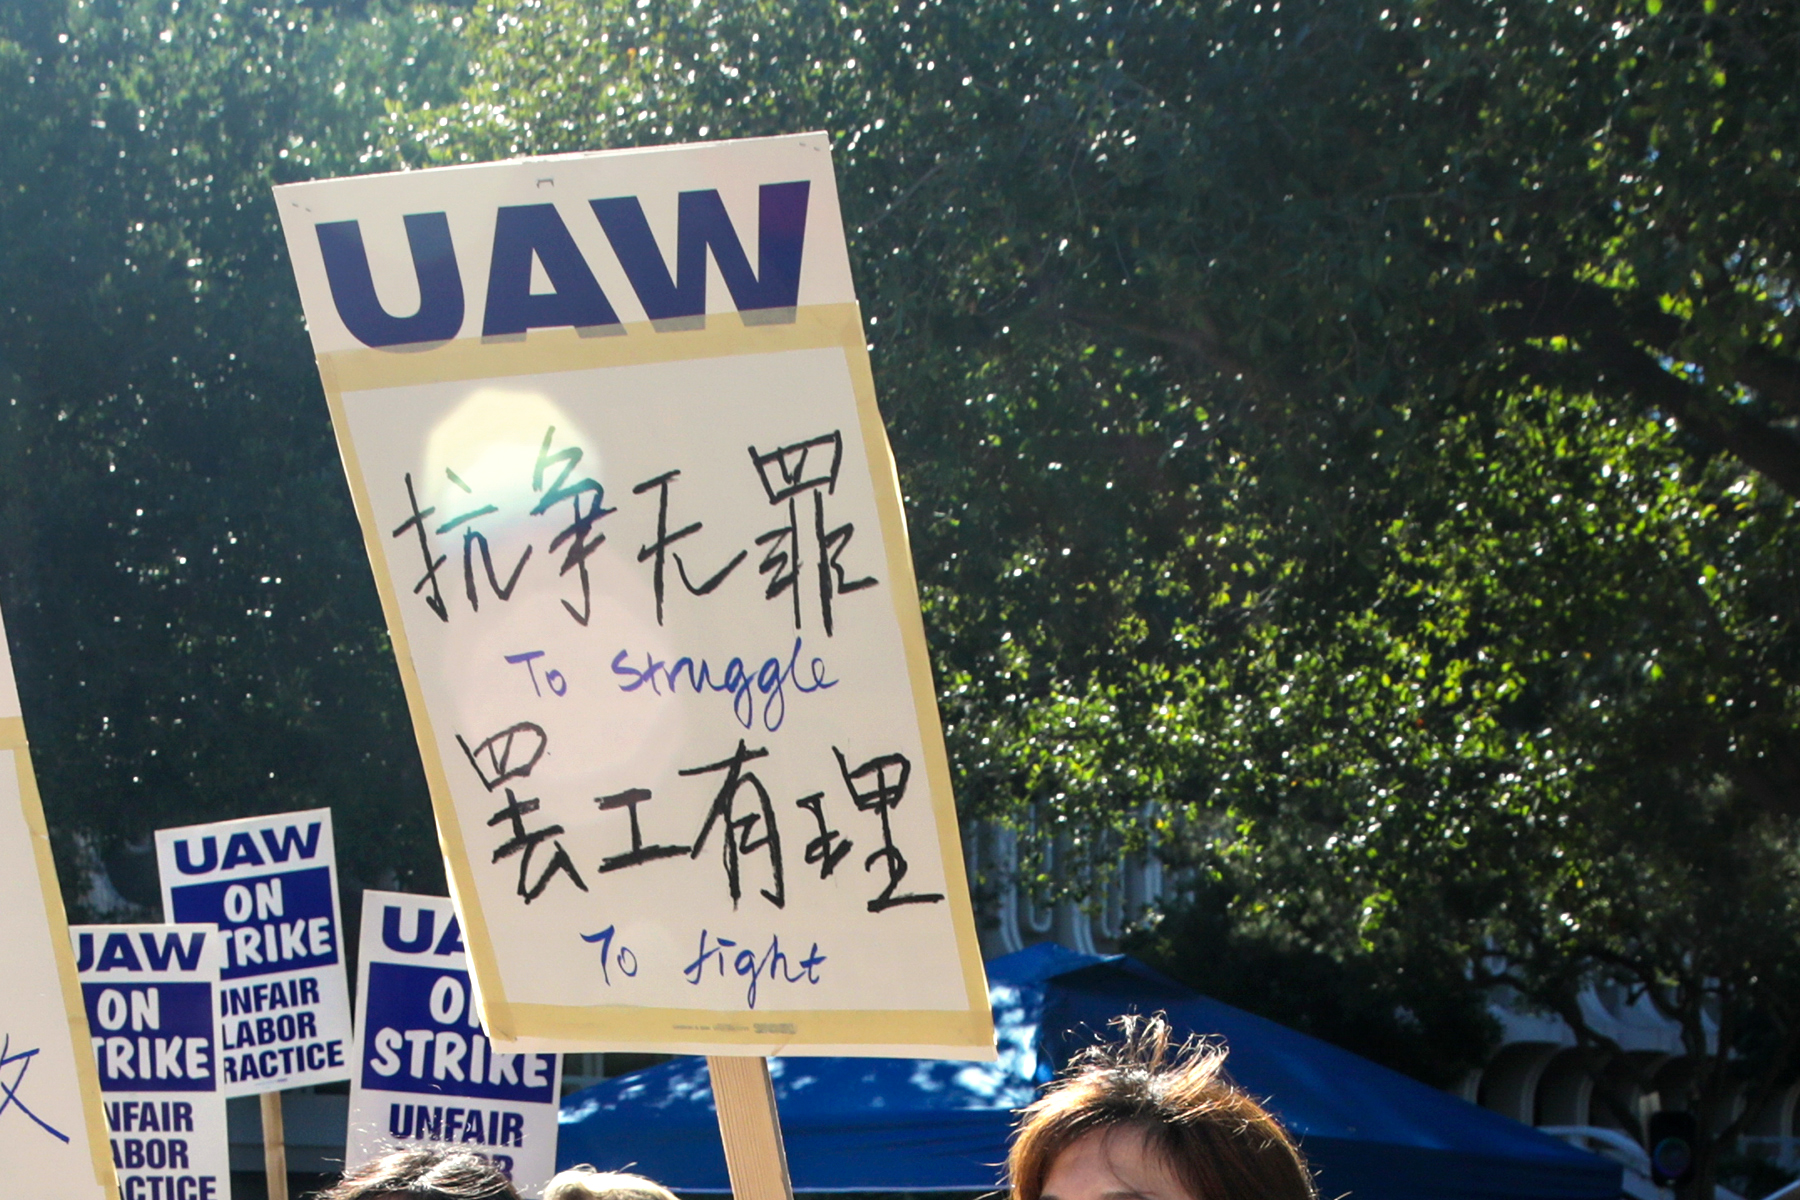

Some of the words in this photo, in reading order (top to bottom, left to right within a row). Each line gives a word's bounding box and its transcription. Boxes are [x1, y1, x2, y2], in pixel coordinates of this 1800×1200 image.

[315, 180, 811, 353] UAW
[504, 649, 568, 698] To
[173, 822, 322, 875] UAW
[224, 878, 284, 922] ON
[219, 917, 333, 970] TRIKE
[97, 987, 160, 1031] ON
[91, 1036, 210, 1080] TRIKE
[223, 1039, 345, 1083] RACTICE
[103, 1101, 194, 1132] NFAIR
[389, 1103, 524, 1147] UNFAIR
[110, 1139, 189, 1169] ABOR
